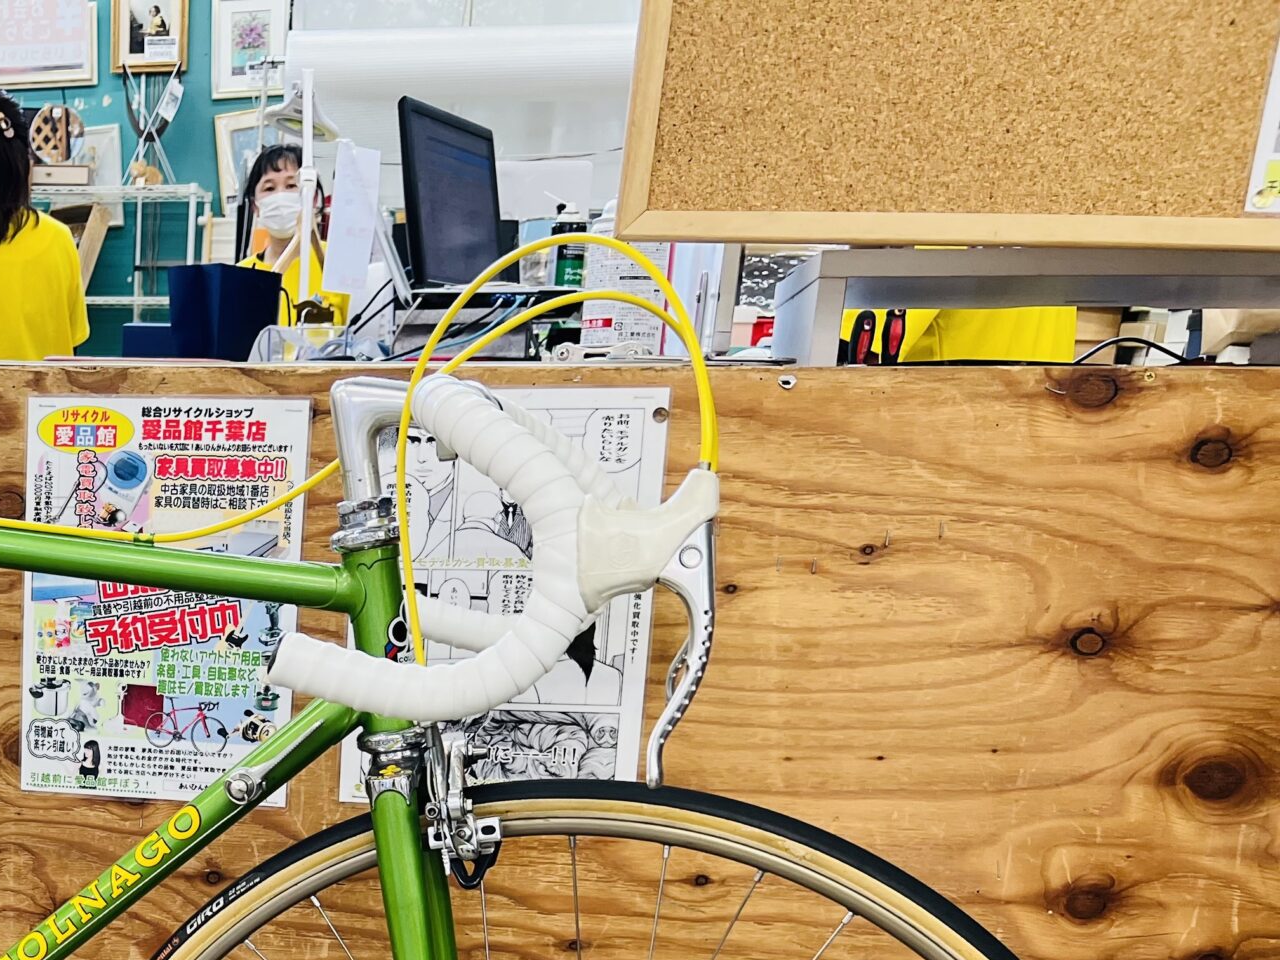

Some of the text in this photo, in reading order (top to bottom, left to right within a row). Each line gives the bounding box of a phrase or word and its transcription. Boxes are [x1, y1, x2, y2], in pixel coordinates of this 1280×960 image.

[62, 410, 110, 422] リサイクル
[141, 406, 254, 418] 総合リサイクルショップ
[55, 426, 116, 446] 愛品館
[141, 419, 267, 442] 愛品館千葉店
[599, 415, 615, 462] 売りたいらしいな
[615, 413, 630, 464] お前、モデルガンを
[155, 455, 286, 481] 家具買取募集中!!
[87, 603, 240, 656] 予約受付中
[629, 593, 642, 664] 強化買取中です!
[160, 648, 261, 666] 使わないアウトドア用品
[34, 725, 65, 739] 荷物減って
[30, 772, 149, 789] 引越前に愛品館呼ぼう!
[186, 896, 224, 934] GIRO
